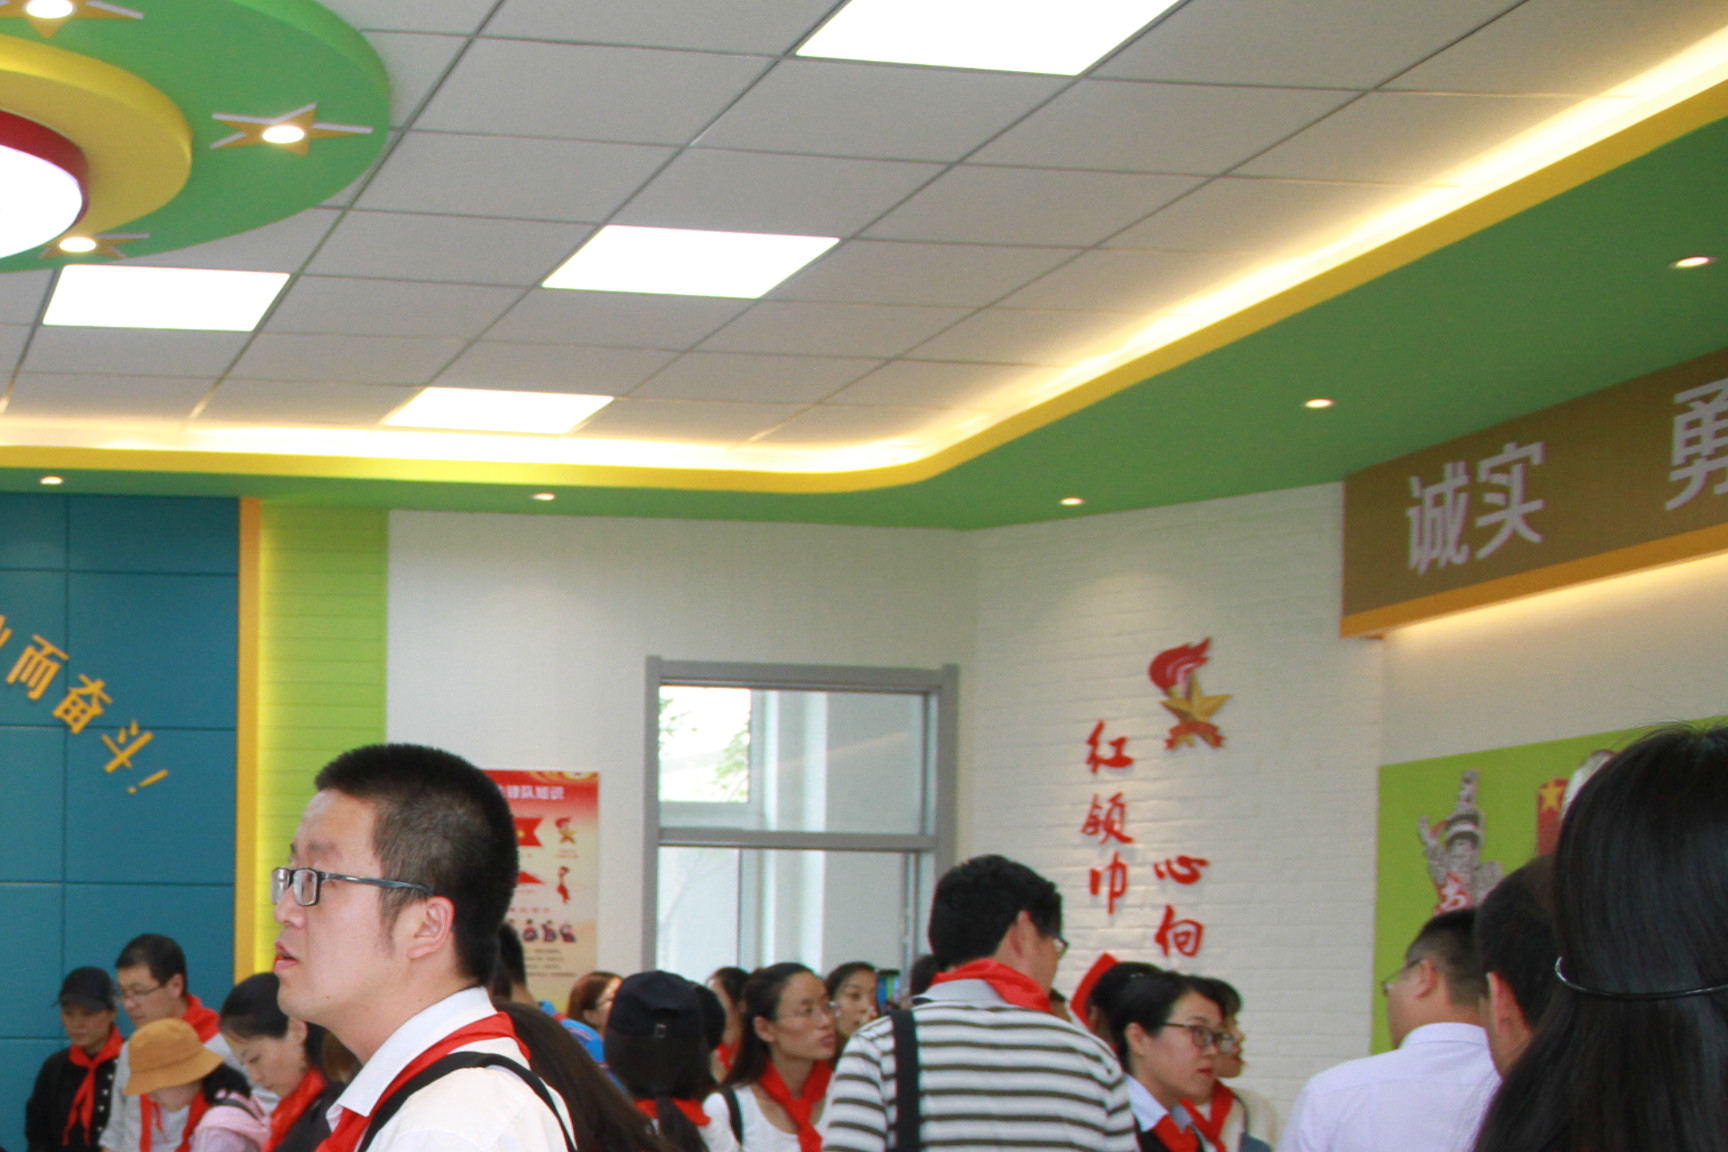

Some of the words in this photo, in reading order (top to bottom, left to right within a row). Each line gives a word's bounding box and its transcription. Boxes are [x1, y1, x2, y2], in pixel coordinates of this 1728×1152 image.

[1405, 441, 1547, 576] 诚实
[1081, 719, 1135, 916] 红领巾
[1153, 855, 1210, 957] 心向
